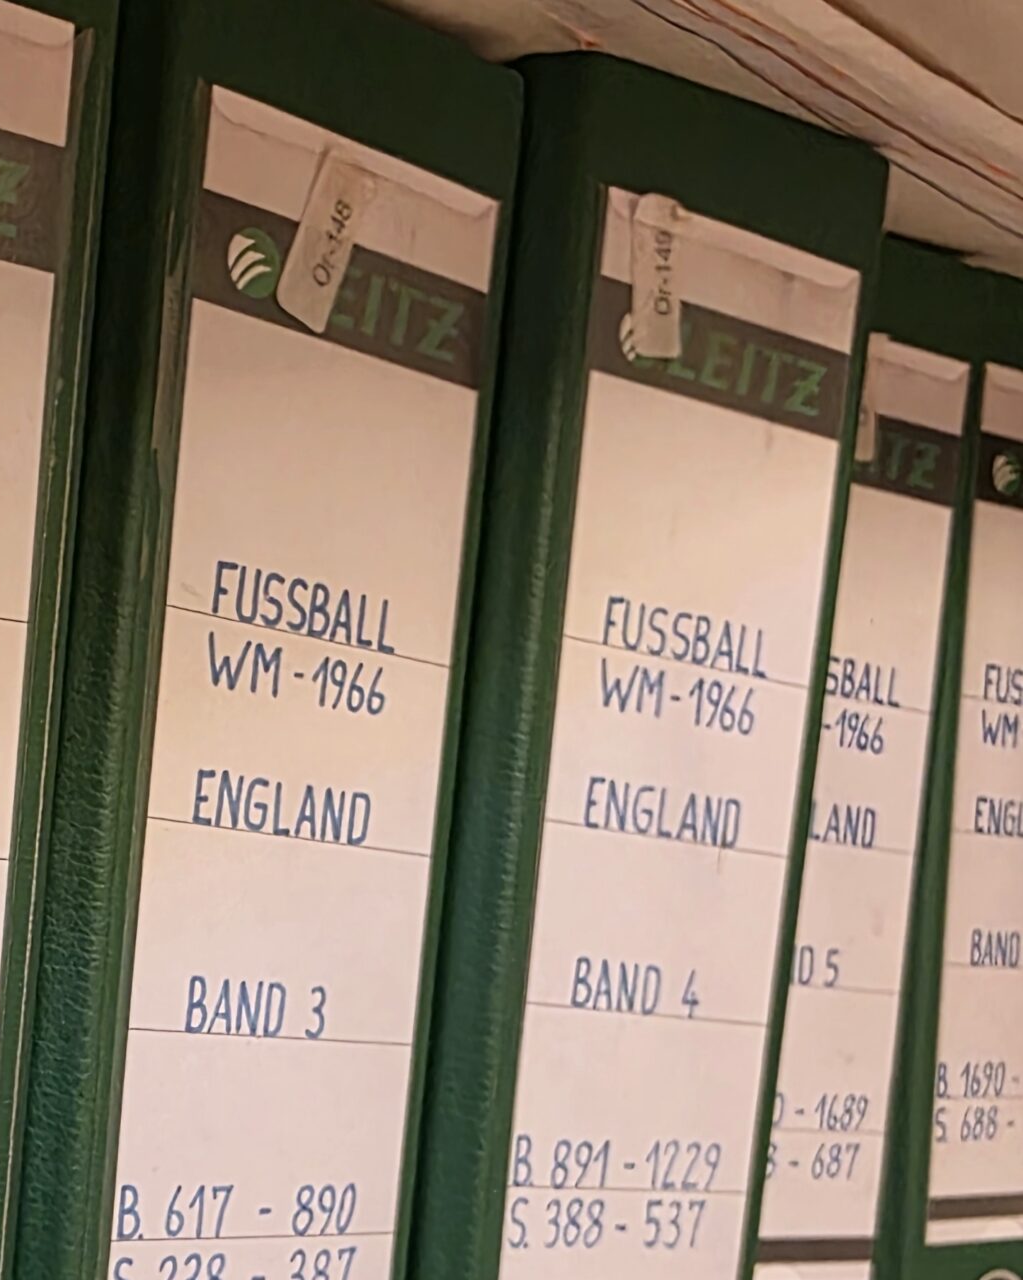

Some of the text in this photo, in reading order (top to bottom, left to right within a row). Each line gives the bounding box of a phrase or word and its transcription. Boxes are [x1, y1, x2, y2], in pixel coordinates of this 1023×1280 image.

[311, 199, 353, 288] Or-148
[654, 229, 674, 316] Or-149
[210, 560, 396, 655] FUSSBALL
[601, 595, 768, 680] FUSSBALL
[191, 768, 372, 847] ENGLAND
[582, 775, 742, 850] ENGLAND
[823, 946, 841, 988] 5
[970, 927, 1021, 969] BAND
[184, 974, 327, 1041] BAND 3
[570, 955, 700, 1020] BAND 4
[959, 1060, 1006, 1099] 1690
[814, 1092, 869, 1132] 1689
[959, 1104, 999, 1142] 688
[549, 1138, 611, 1190] 891
[645, 1138, 722, 1193] 1229
[810, 1141, 861, 1181] 687
[116, 1183, 145, 1242] B.
[164, 1183, 234, 1241] 617
[291, 1182, 358, 1237] 890
[543, 1196, 606, 1249] 388
[642, 1199, 707, 1249] 537
